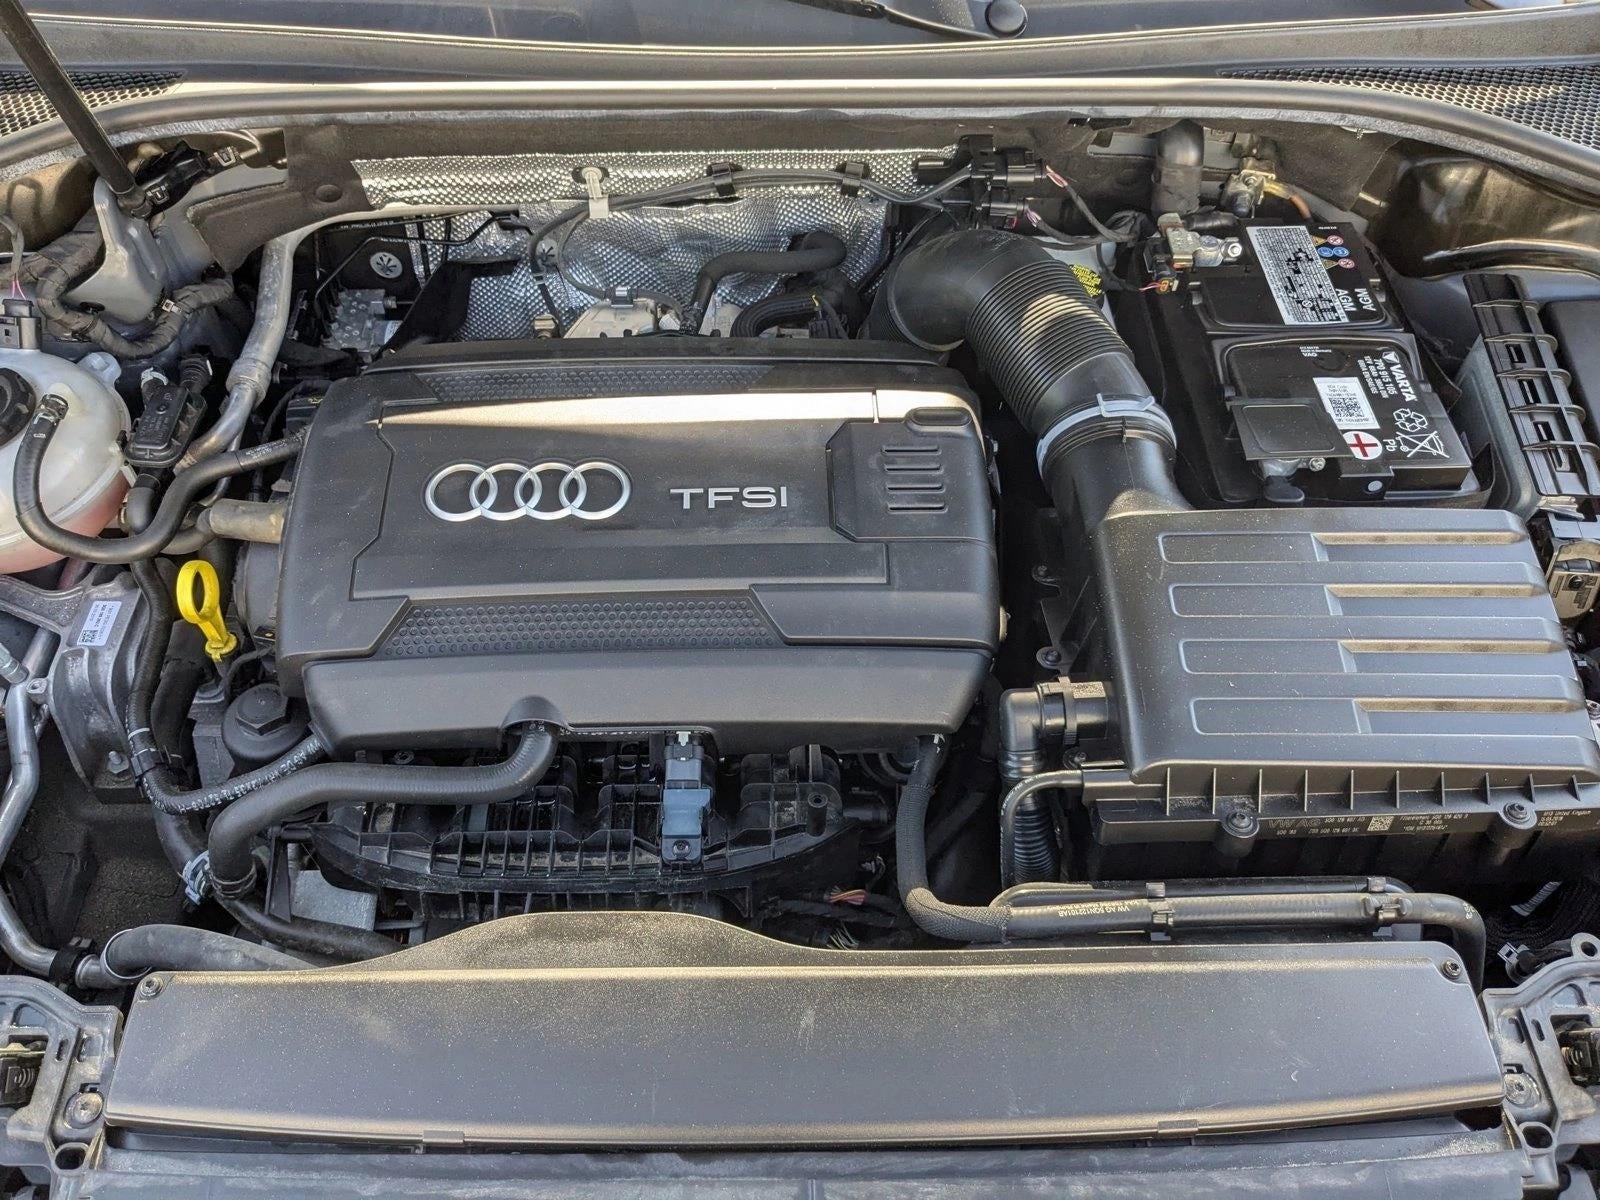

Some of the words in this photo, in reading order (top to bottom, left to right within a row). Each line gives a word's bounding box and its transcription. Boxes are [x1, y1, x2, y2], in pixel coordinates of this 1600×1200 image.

[1335, 288, 1357, 311] AGM
[1354, 288, 1377, 311] AGM
[1379, 371, 1392, 382] 915
[1389, 364, 1417, 402] VARTA
[1385, 383, 1398, 395] 105
[1383, 439, 1397, 452] Pb
[670, 486, 787, 509] TFSI
